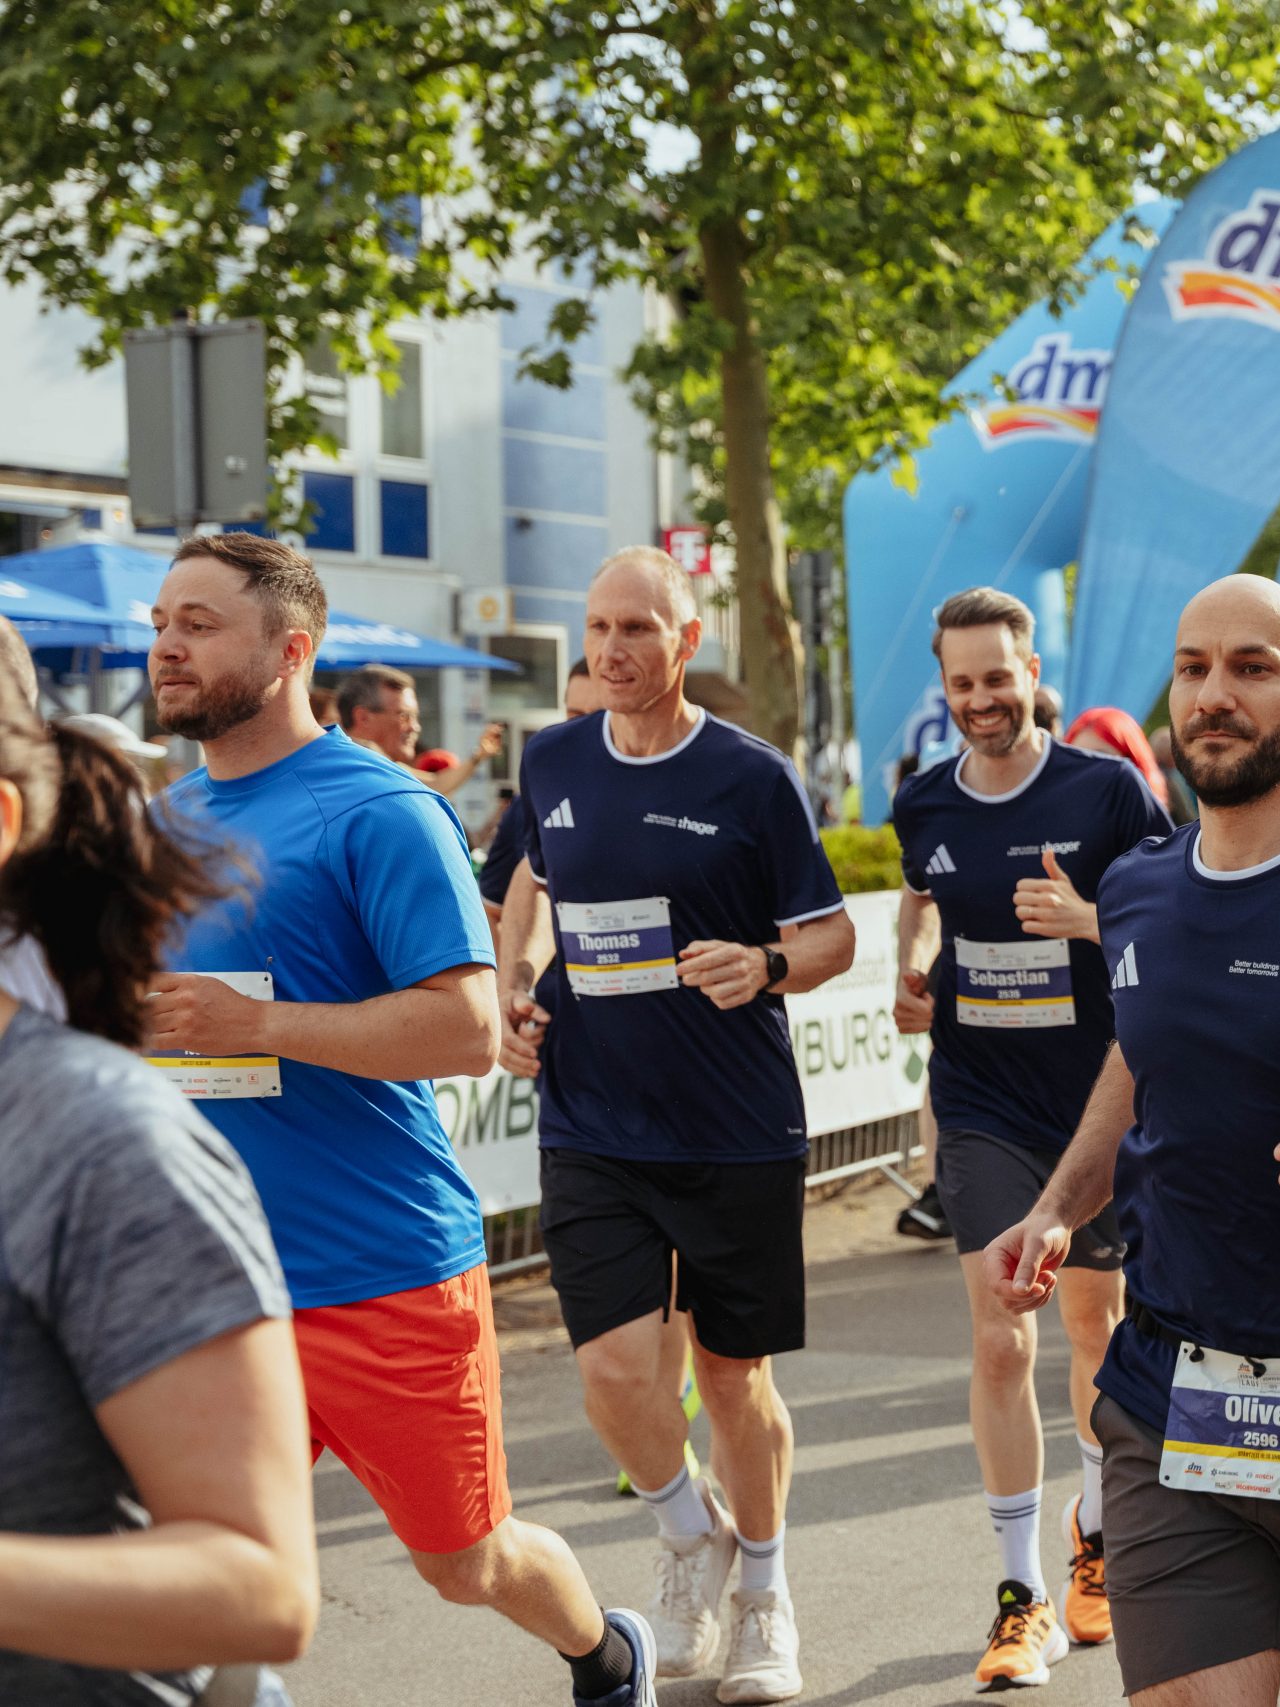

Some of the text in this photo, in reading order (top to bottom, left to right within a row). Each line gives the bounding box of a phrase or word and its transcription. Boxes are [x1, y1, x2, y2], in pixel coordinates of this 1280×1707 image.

[577, 933, 640, 951] Thomas
[1228, 966, 1278, 977] Better tomorrows
[1234, 960, 1280, 971] Better buildings
[968, 969, 1050, 987] Sebastian
[794, 1009, 892, 1077] BURG
[1243, 1431, 1279, 1448] 2596
[1187, 1462, 1202, 1471] dm
